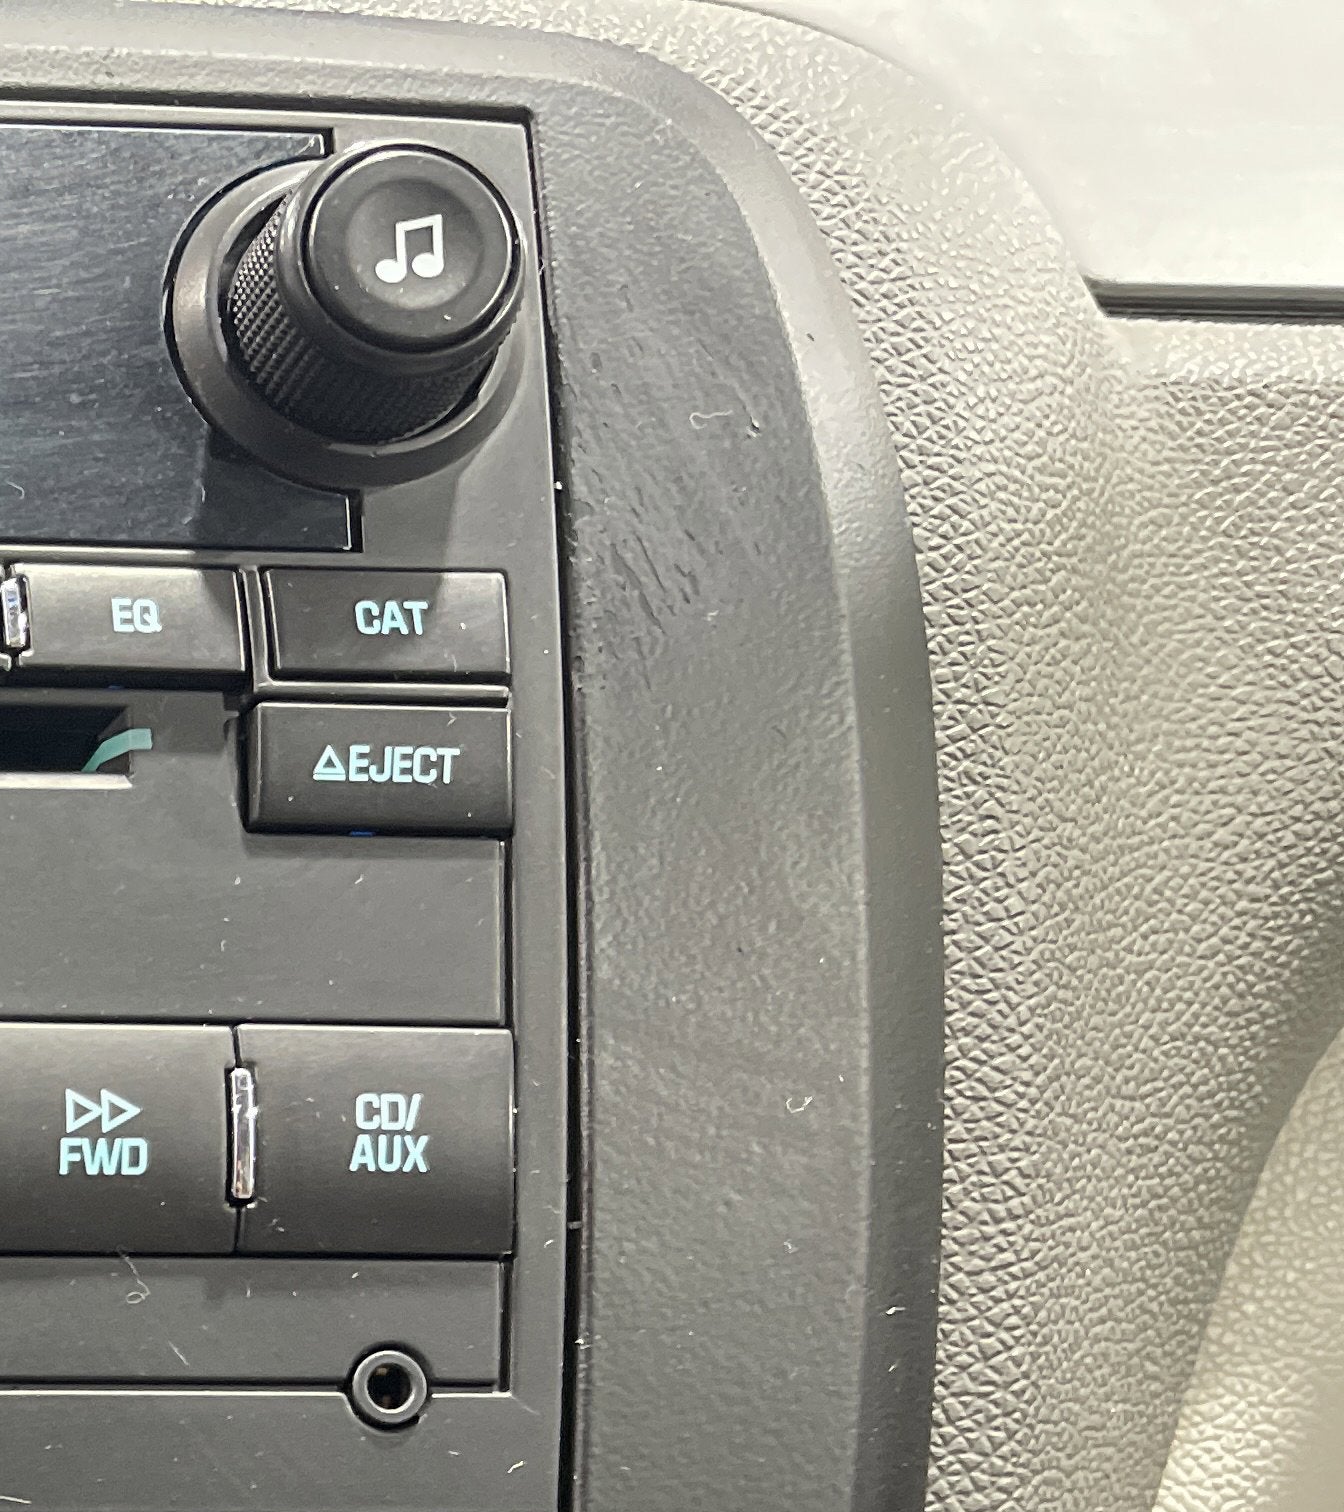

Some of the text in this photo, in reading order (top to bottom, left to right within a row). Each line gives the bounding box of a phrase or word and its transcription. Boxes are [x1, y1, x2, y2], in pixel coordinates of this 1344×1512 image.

[111, 596, 163, 634] EQ
[354, 600, 429, 636] CAT
[348, 746, 461, 784] EJECT
[355, 1092, 422, 1132] CD/
[59, 1137, 149, 1176] FWD
[349, 1133, 430, 1173] AUX
